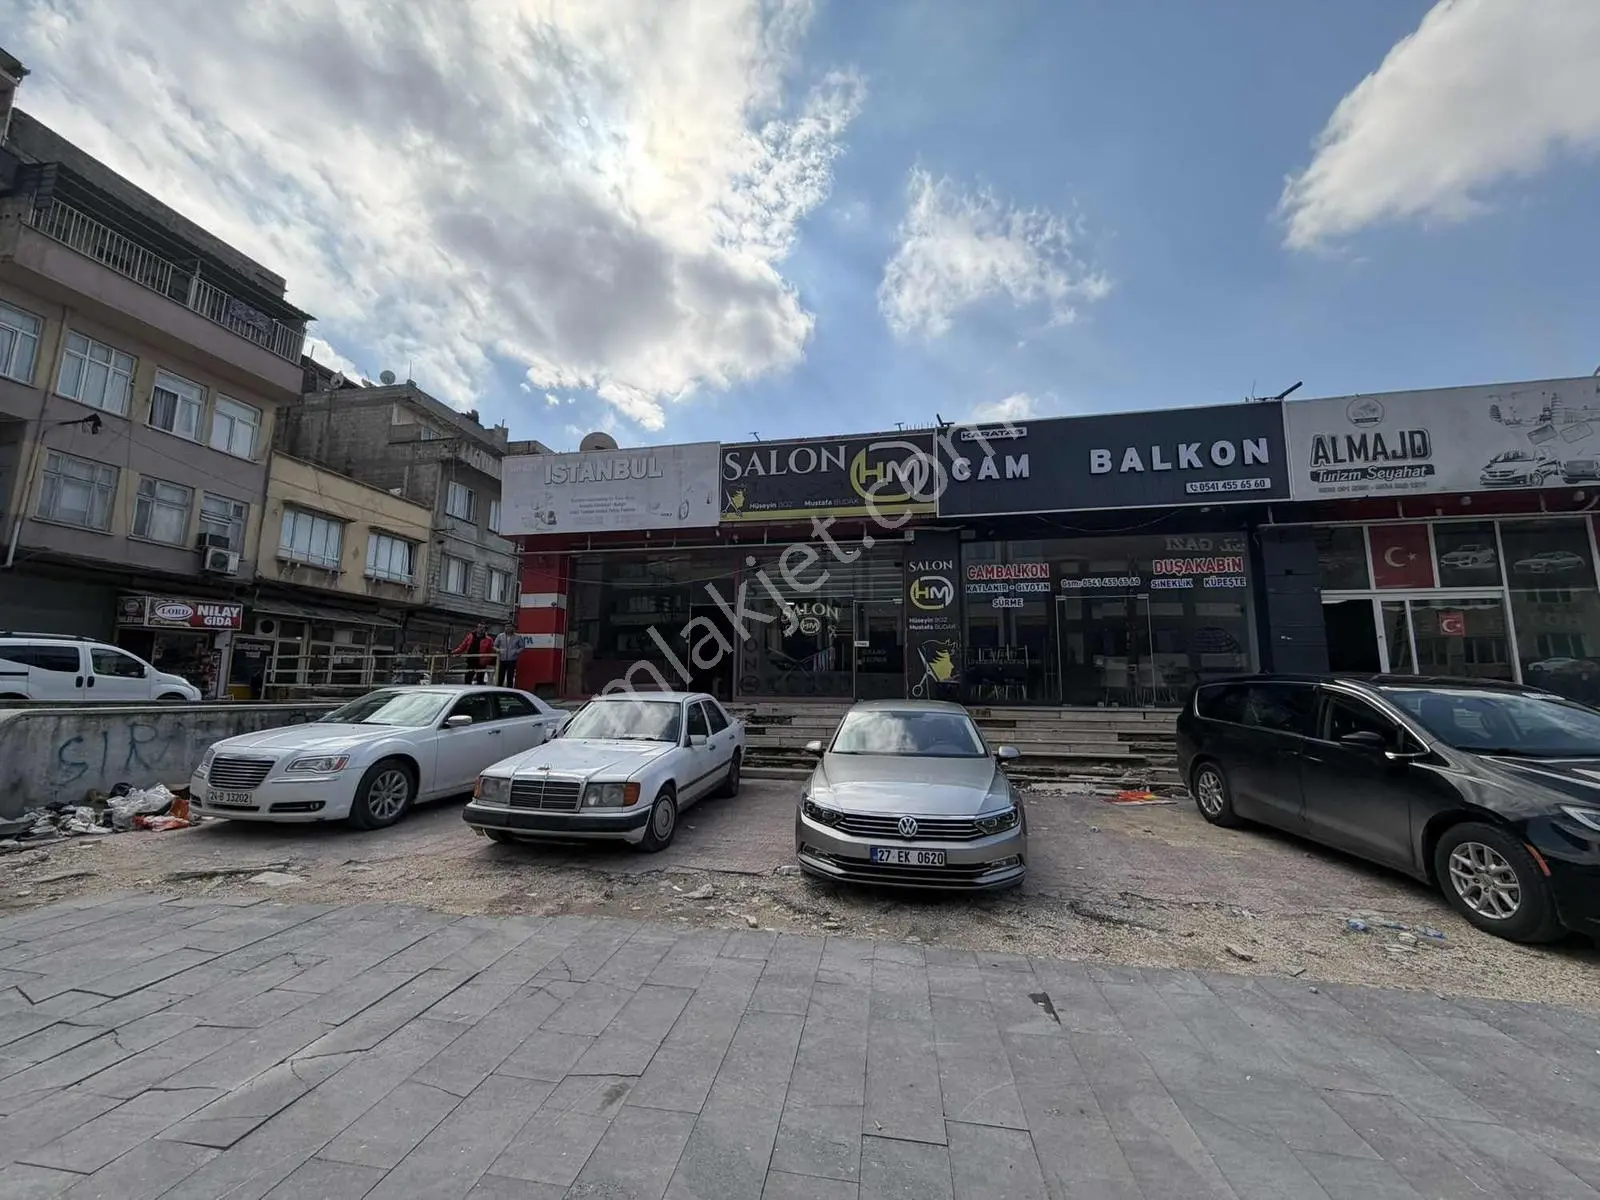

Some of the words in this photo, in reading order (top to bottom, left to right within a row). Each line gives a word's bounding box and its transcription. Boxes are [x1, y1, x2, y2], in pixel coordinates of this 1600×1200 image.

[1312, 429, 1430, 465] ALMAJD
[722, 444, 846, 481] SALON
[951, 454, 1030, 481] CAM
[1089, 438, 1269, 474] BALKON
[1318, 469, 1361, 482] Turizm
[1366, 466, 1426, 481] Seyahat
[1199, 482, 1219, 491] 0541
[1221, 481, 1238, 489] 455
[1240, 480, 1251, 488] 65
[1254, 479, 1265, 487] 60
[749, 502, 777, 510] Hüseyin
[804, 499, 833, 507] Mustafa
[908, 560, 953, 572] SALON
[967, 563, 1050, 580] CAMBALKON
[1152, 556, 1243, 576] DUŞAKABİN
[1203, 576, 1247, 588] KÜPEŞTE
[992, 597, 1024, 607] SÜRME
[204, 615, 232, 627] GIDA
[878, 850, 891, 862] 27
[898, 851, 910, 863] EK
[917, 852, 944, 865] 0620
